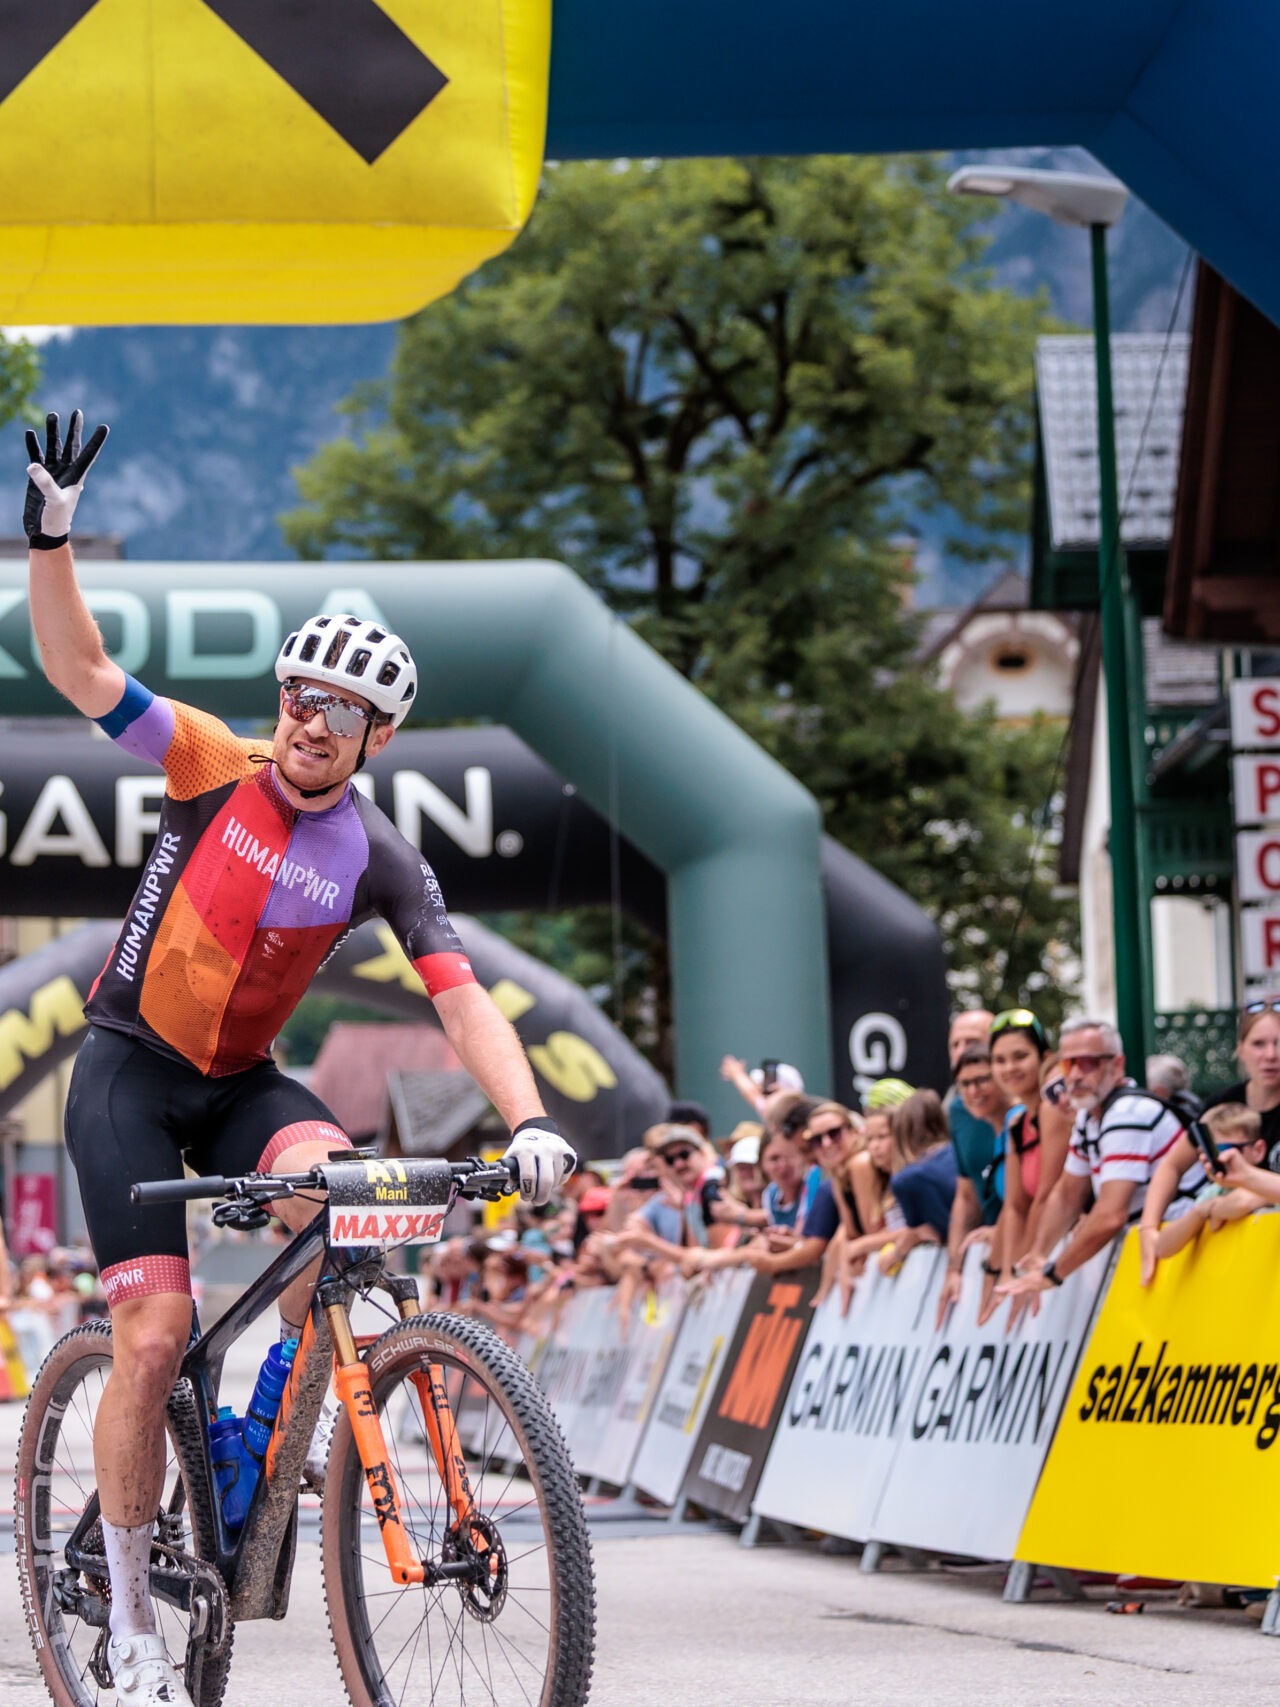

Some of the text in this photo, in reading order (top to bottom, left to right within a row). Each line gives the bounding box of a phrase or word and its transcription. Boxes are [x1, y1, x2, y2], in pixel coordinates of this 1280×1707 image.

[221, 816, 340, 910] HUMANPWR
[116, 832, 181, 982] HUMANPWR
[332, 1213, 445, 1239] MAXXIS
[375, 1187, 407, 1200] Mani
[371, 1336, 455, 1373] SCHWALBE
[789, 1343, 920, 1438] GARMIN
[910, 1341, 1068, 1446] GARMIN
[365, 1462, 400, 1531] FOX
